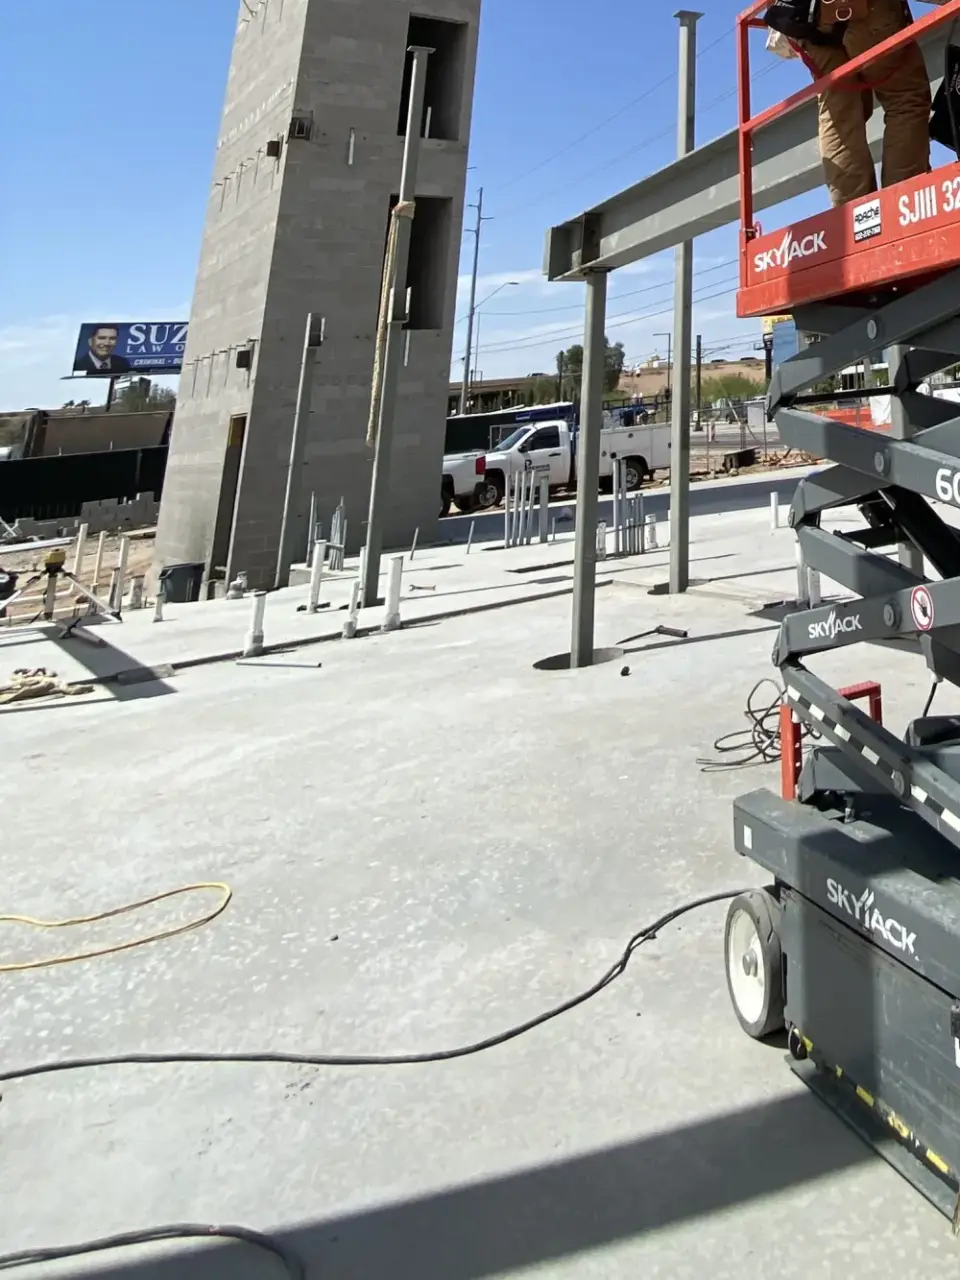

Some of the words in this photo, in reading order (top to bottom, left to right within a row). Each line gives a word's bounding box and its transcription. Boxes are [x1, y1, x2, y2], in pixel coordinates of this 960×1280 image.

[753, 230, 828, 273] SKYJACK
[126, 345, 164, 353] LAW
[807, 609, 863, 640] SKYJACK
[826, 877, 918, 955] SKYJACK
